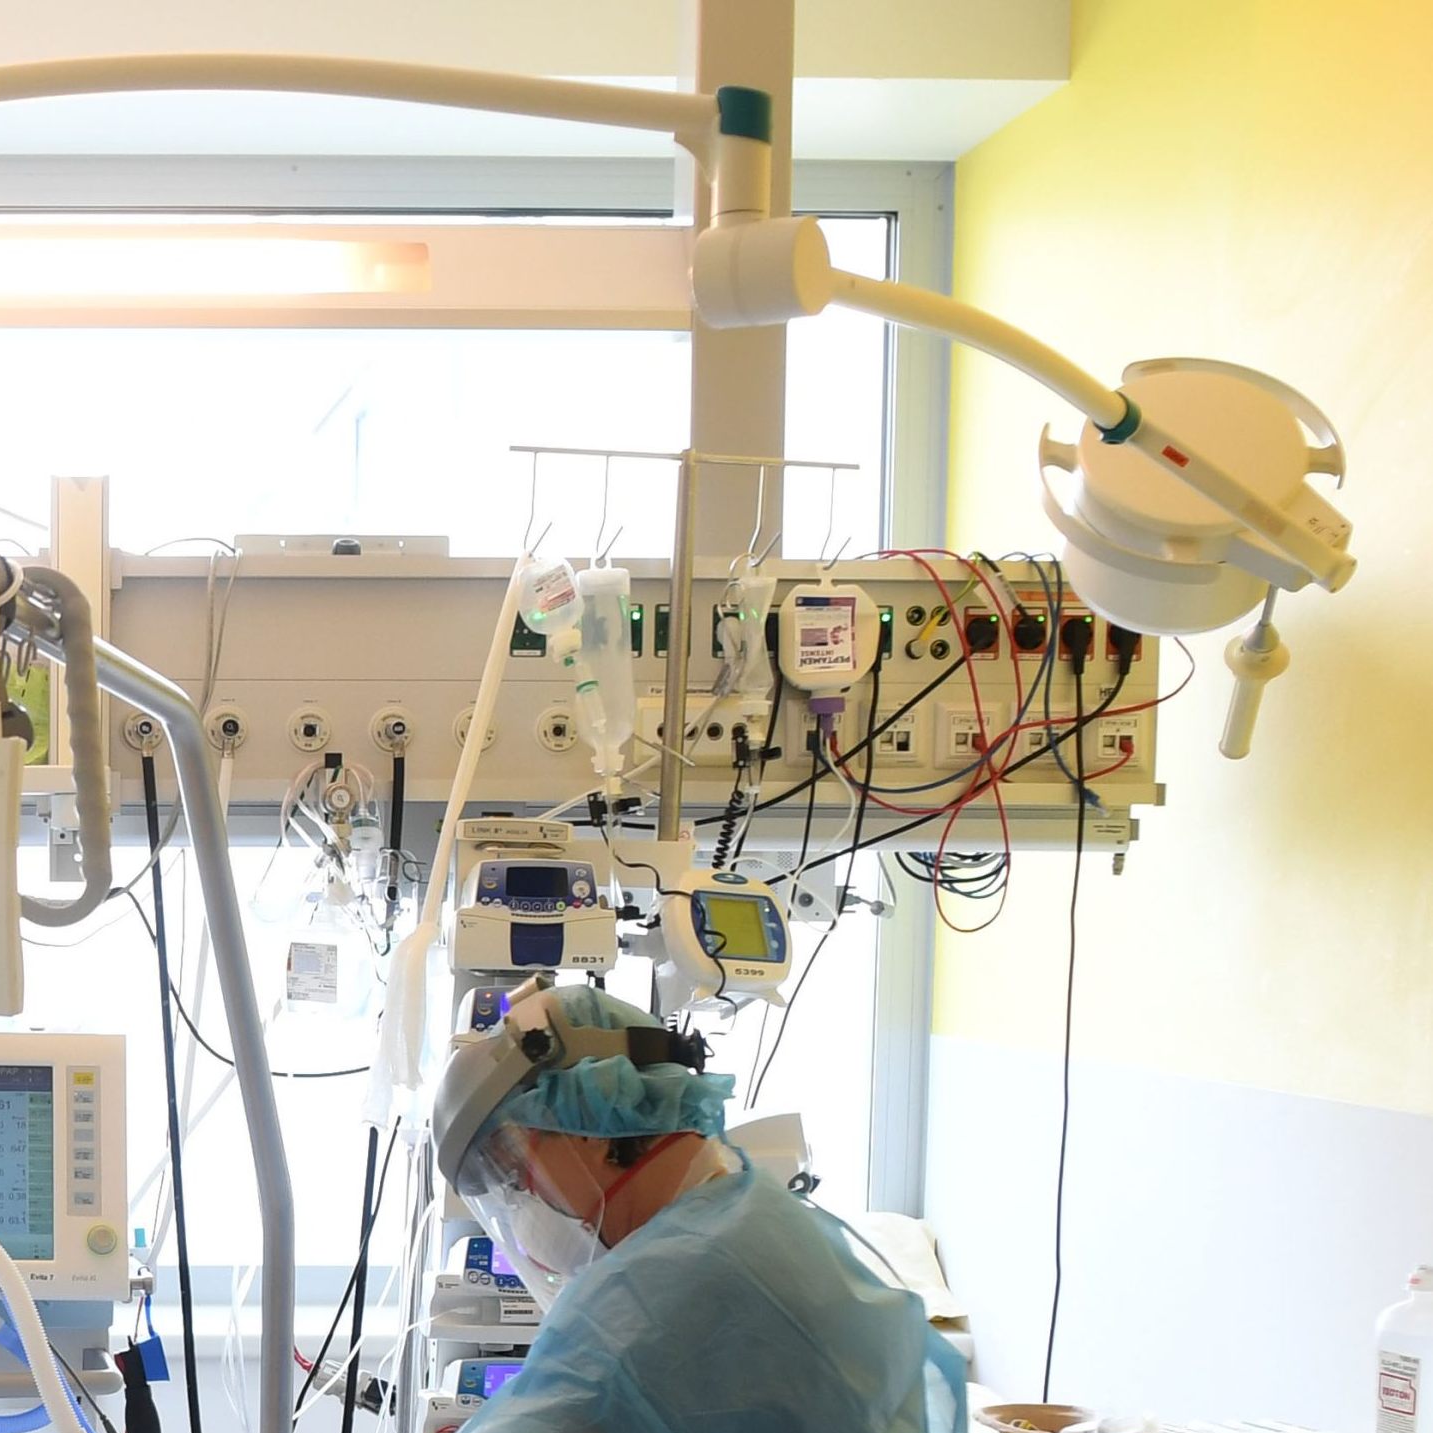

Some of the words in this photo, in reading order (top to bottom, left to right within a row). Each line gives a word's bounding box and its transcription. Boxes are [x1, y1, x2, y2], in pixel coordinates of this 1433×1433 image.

[799, 656, 851, 667] PEPTAMEN
[572, 956, 605, 964] 8831
[734, 968, 765, 976] 5399
